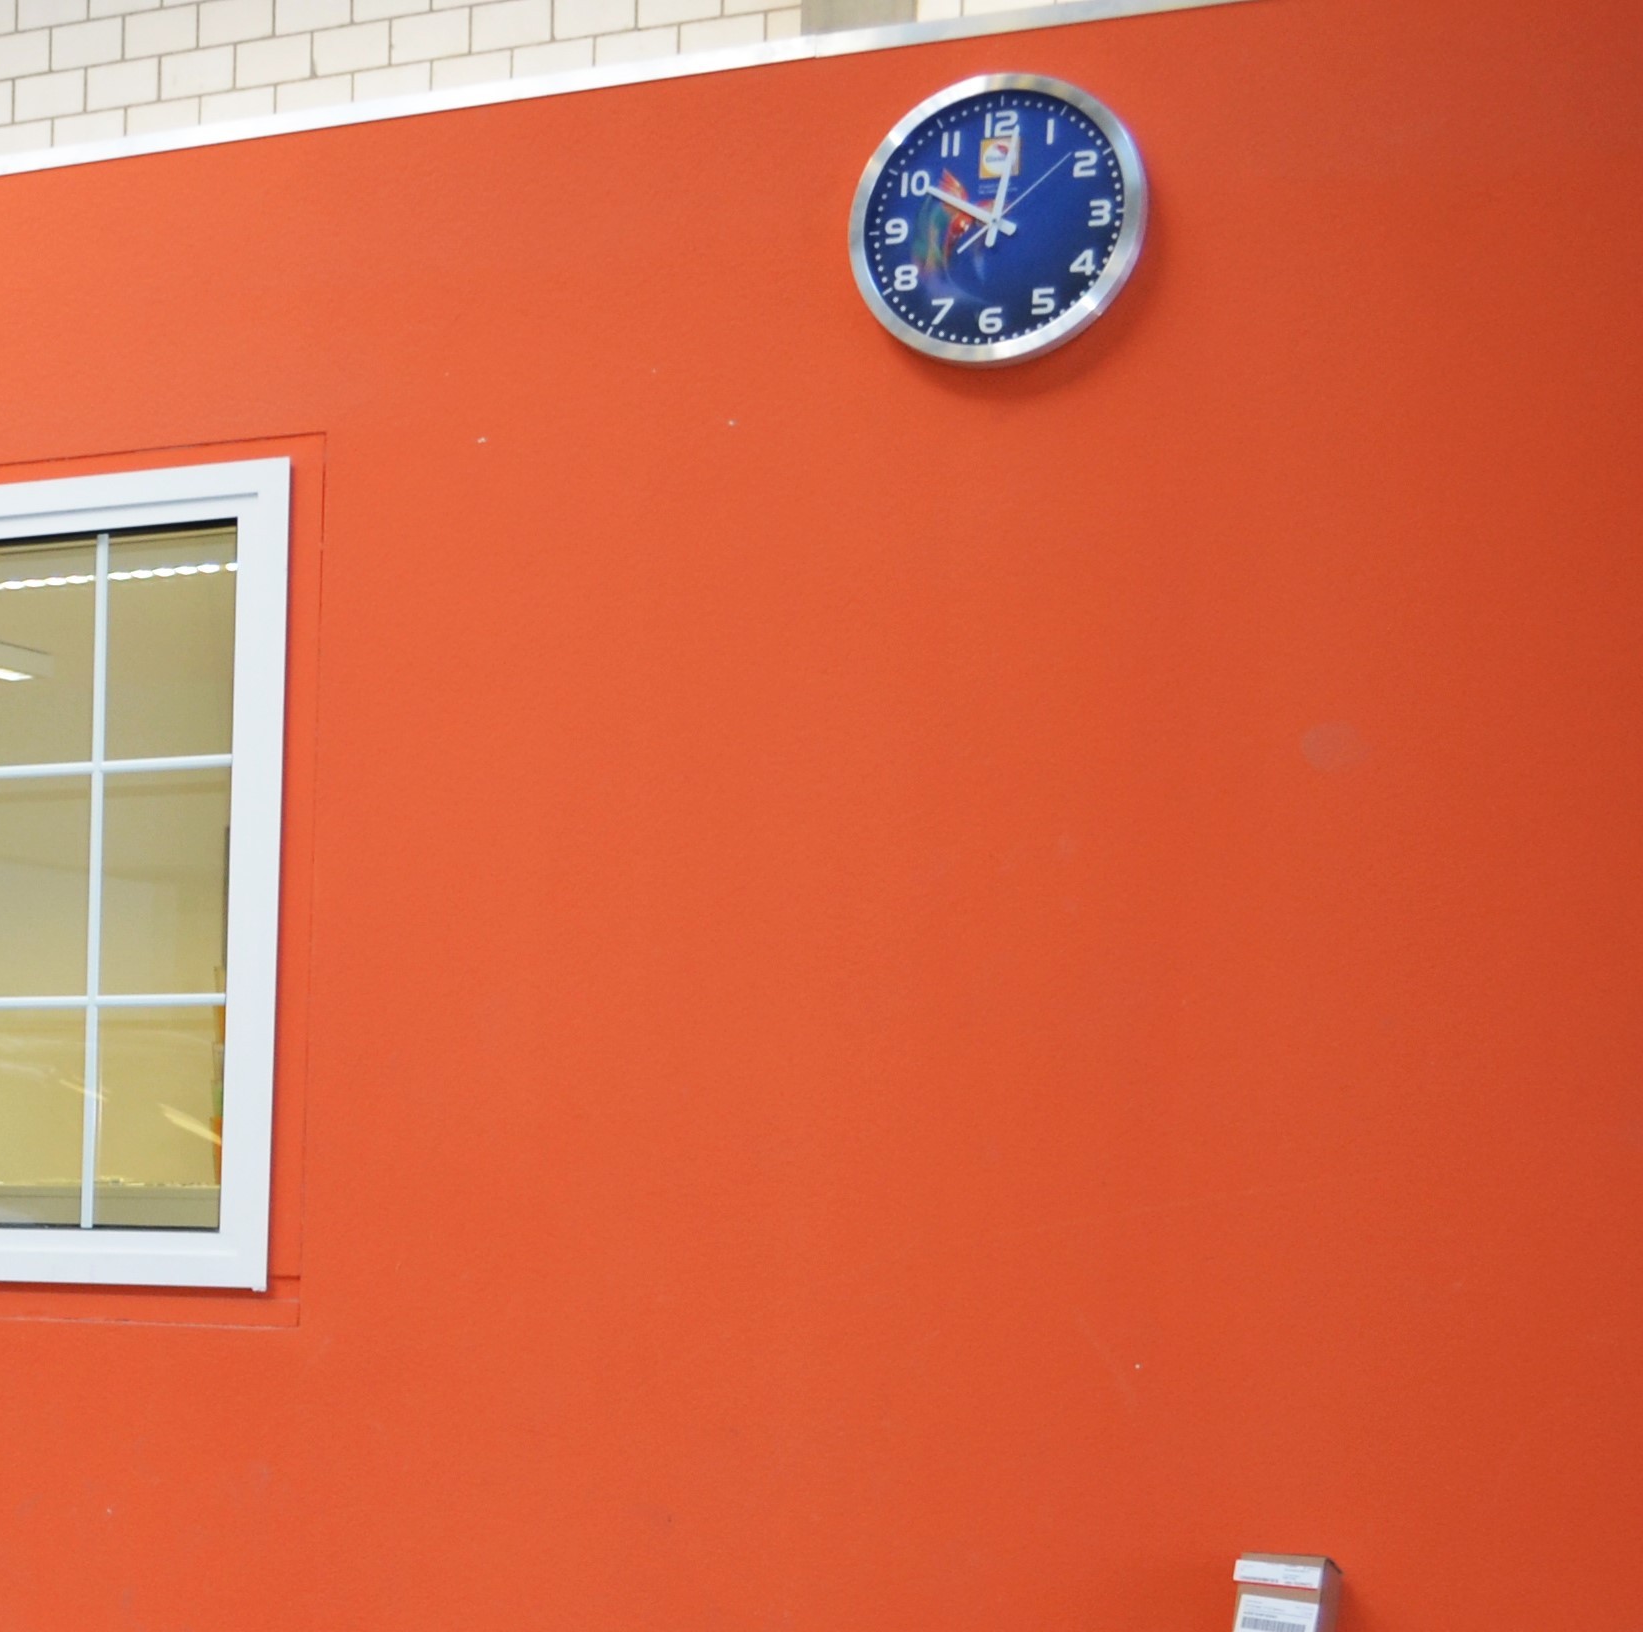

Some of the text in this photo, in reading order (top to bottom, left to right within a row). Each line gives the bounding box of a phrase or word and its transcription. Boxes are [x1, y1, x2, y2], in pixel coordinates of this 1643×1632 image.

[984, 110, 1019, 138] 12
[1046, 118, 1055, 146] 1
[941, 131, 961, 158] 11
[1073, 150, 1098, 178] 2
[900, 170, 930, 198] 10
[1088, 199, 1112, 227] 3
[884, 218, 909, 245] 9
[1069, 249, 1096, 276] 4
[893, 264, 919, 291] 8
[931, 298, 955, 325] 7
[1031, 287, 1056, 315] 5
[978, 307, 1003, 334] 6
